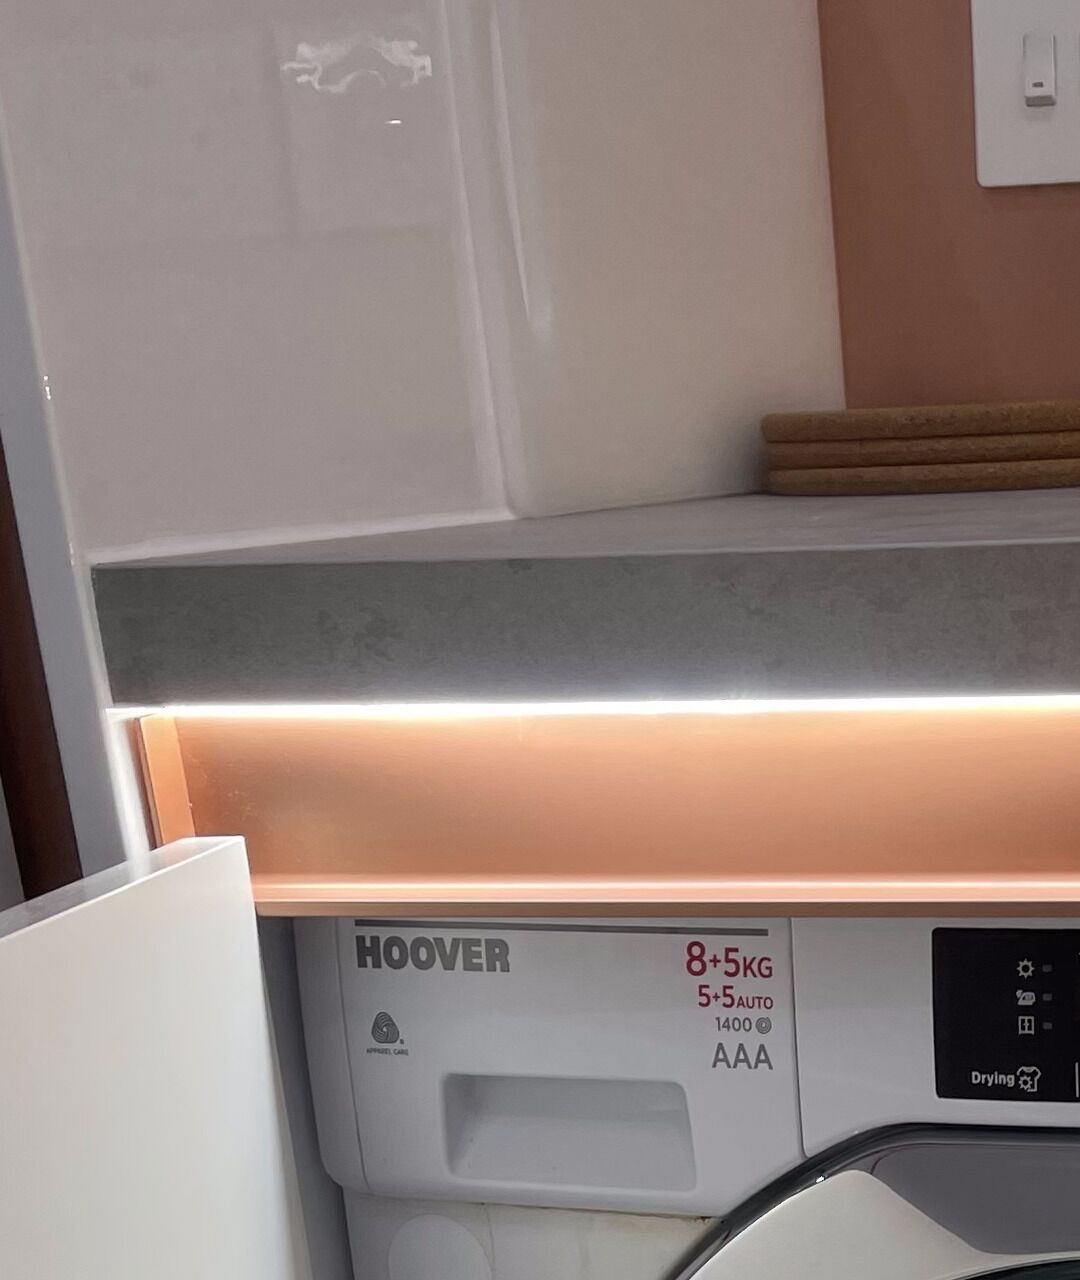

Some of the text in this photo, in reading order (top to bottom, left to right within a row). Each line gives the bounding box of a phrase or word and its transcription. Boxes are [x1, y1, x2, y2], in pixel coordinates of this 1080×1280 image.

[355, 935, 510, 972] HOOVER
[715, 1017, 752, 1032] 1400
[712, 1042, 774, 1070] AAA
[971, 1071, 1016, 1087] Drying
